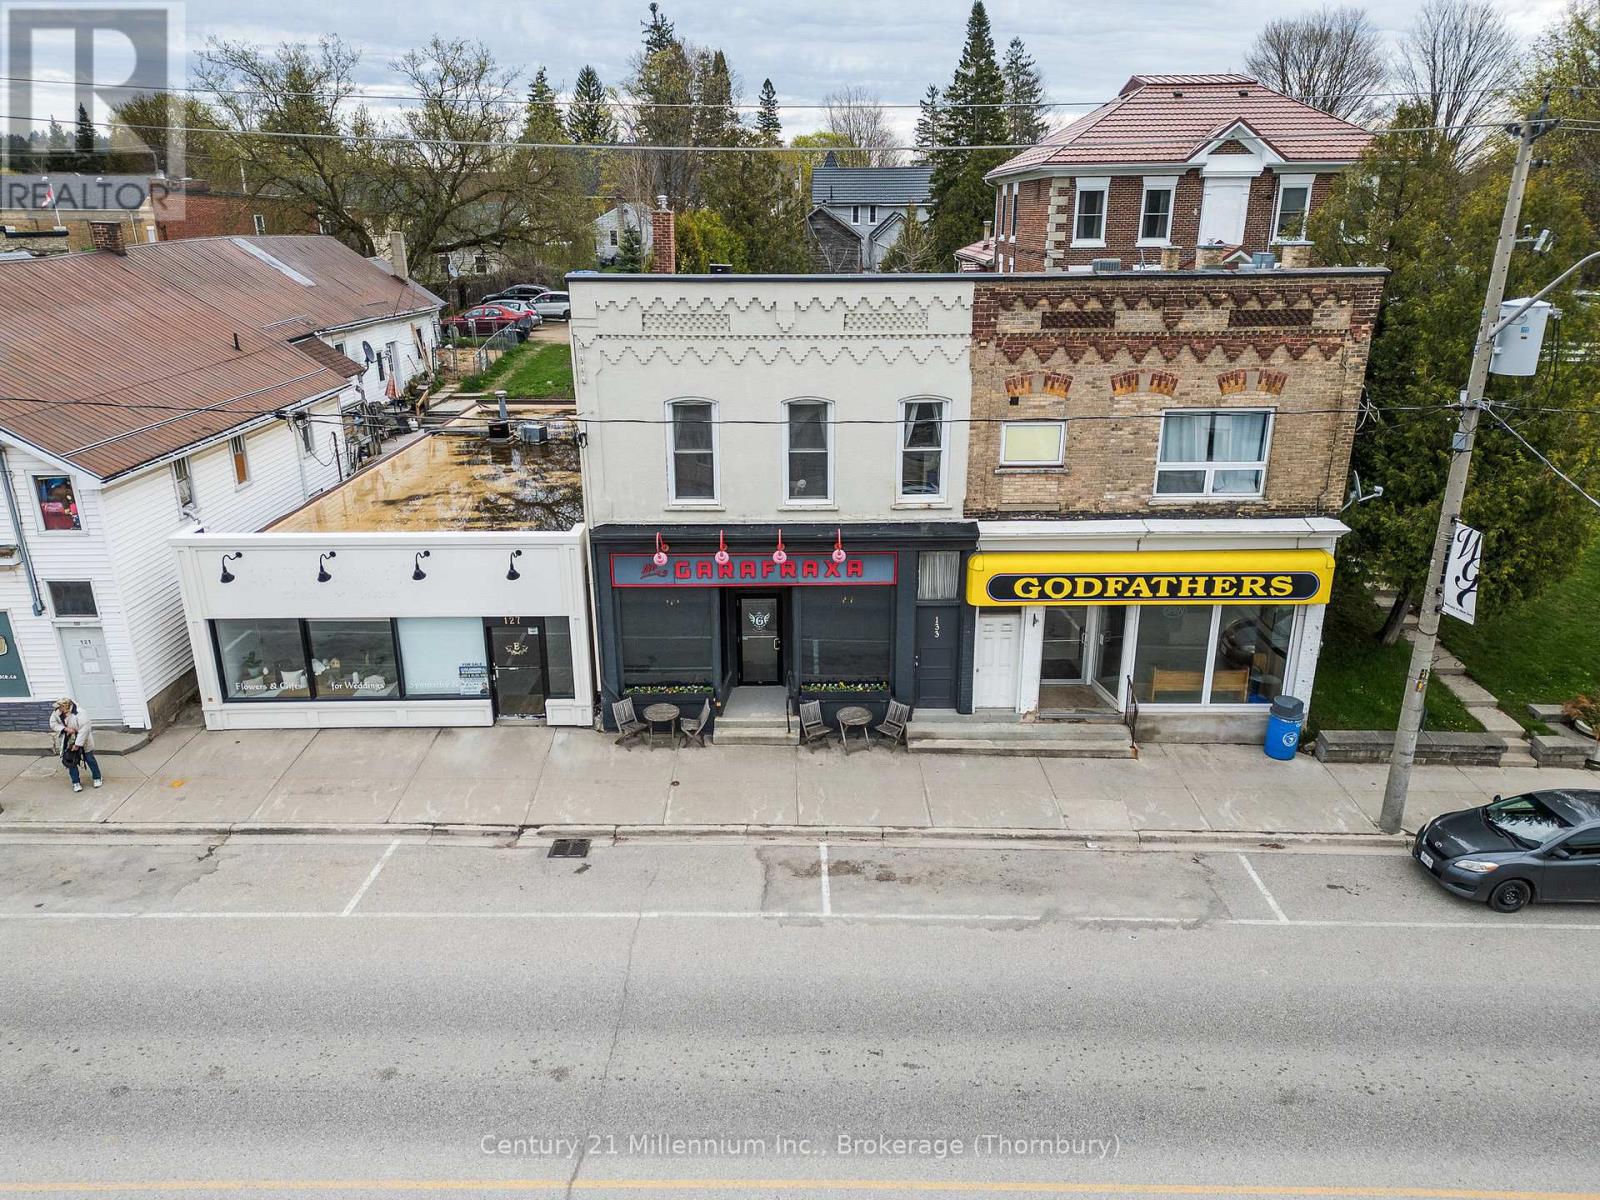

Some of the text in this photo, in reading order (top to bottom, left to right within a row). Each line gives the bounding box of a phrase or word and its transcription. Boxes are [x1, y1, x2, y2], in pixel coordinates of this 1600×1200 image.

[674, 559, 865, 580] GARAFRAXA
[1013, 575, 1294, 599] GODFATHERS
[504, 616, 521, 625] 127
[235, 682, 268, 690] Flowers
[270, 682, 278, 690] &
[331, 681, 343, 691] for
[344, 681, 385, 690] Weddings
